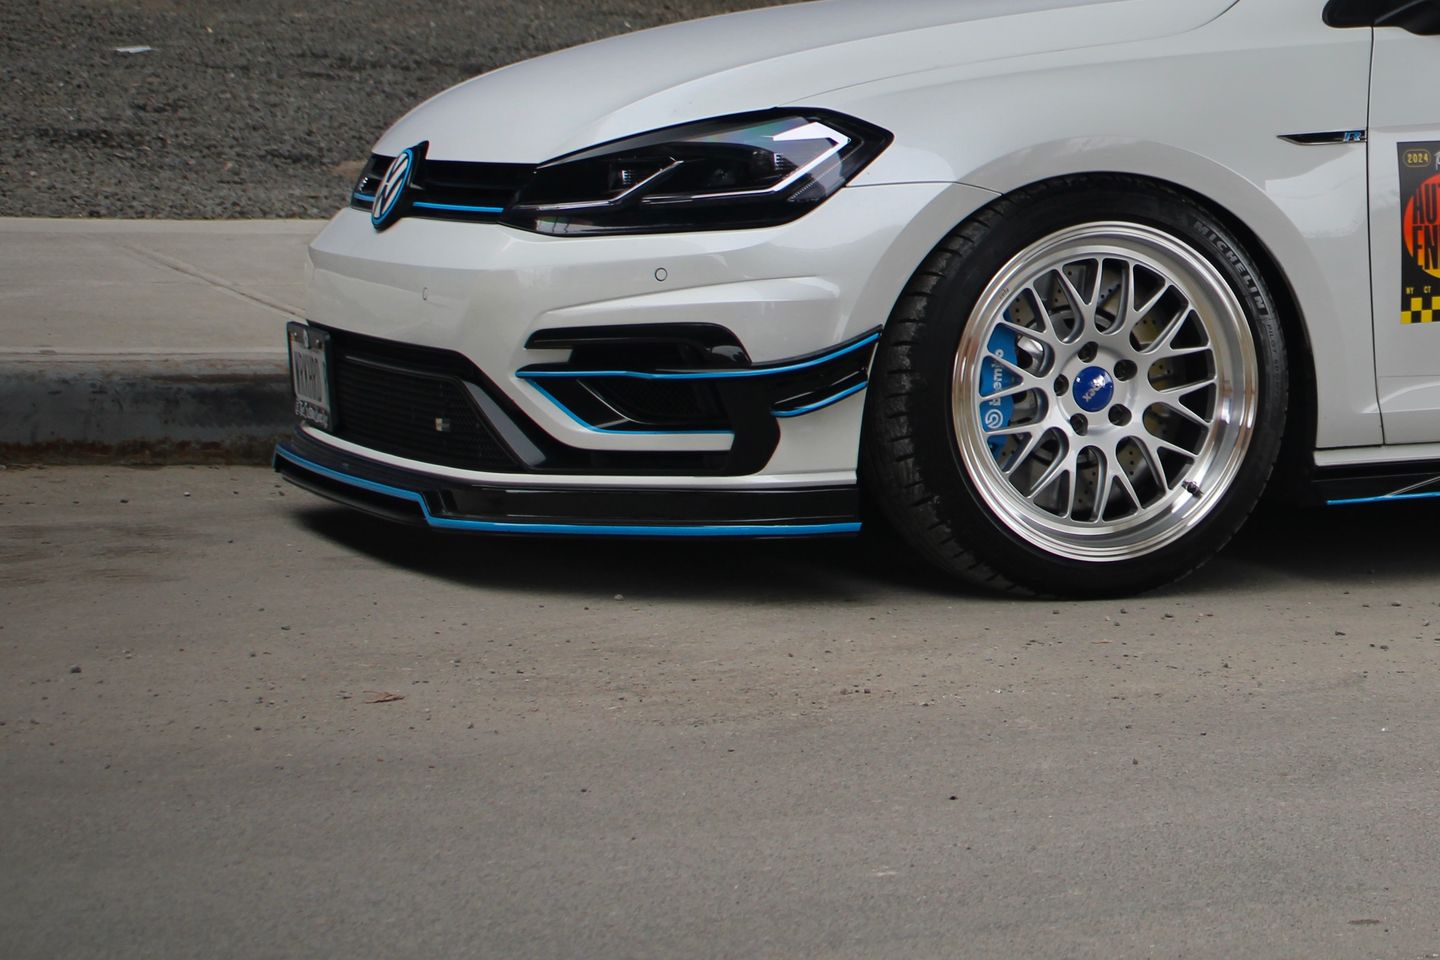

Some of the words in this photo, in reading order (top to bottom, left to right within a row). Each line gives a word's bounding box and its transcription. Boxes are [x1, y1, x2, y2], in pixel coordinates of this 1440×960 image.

[1407, 152, 1429, 164] 2024
[1193, 220, 1270, 313] MICHELIN
[1405, 286, 1414, 295] NY
[1423, 285, 1432, 294] CT
